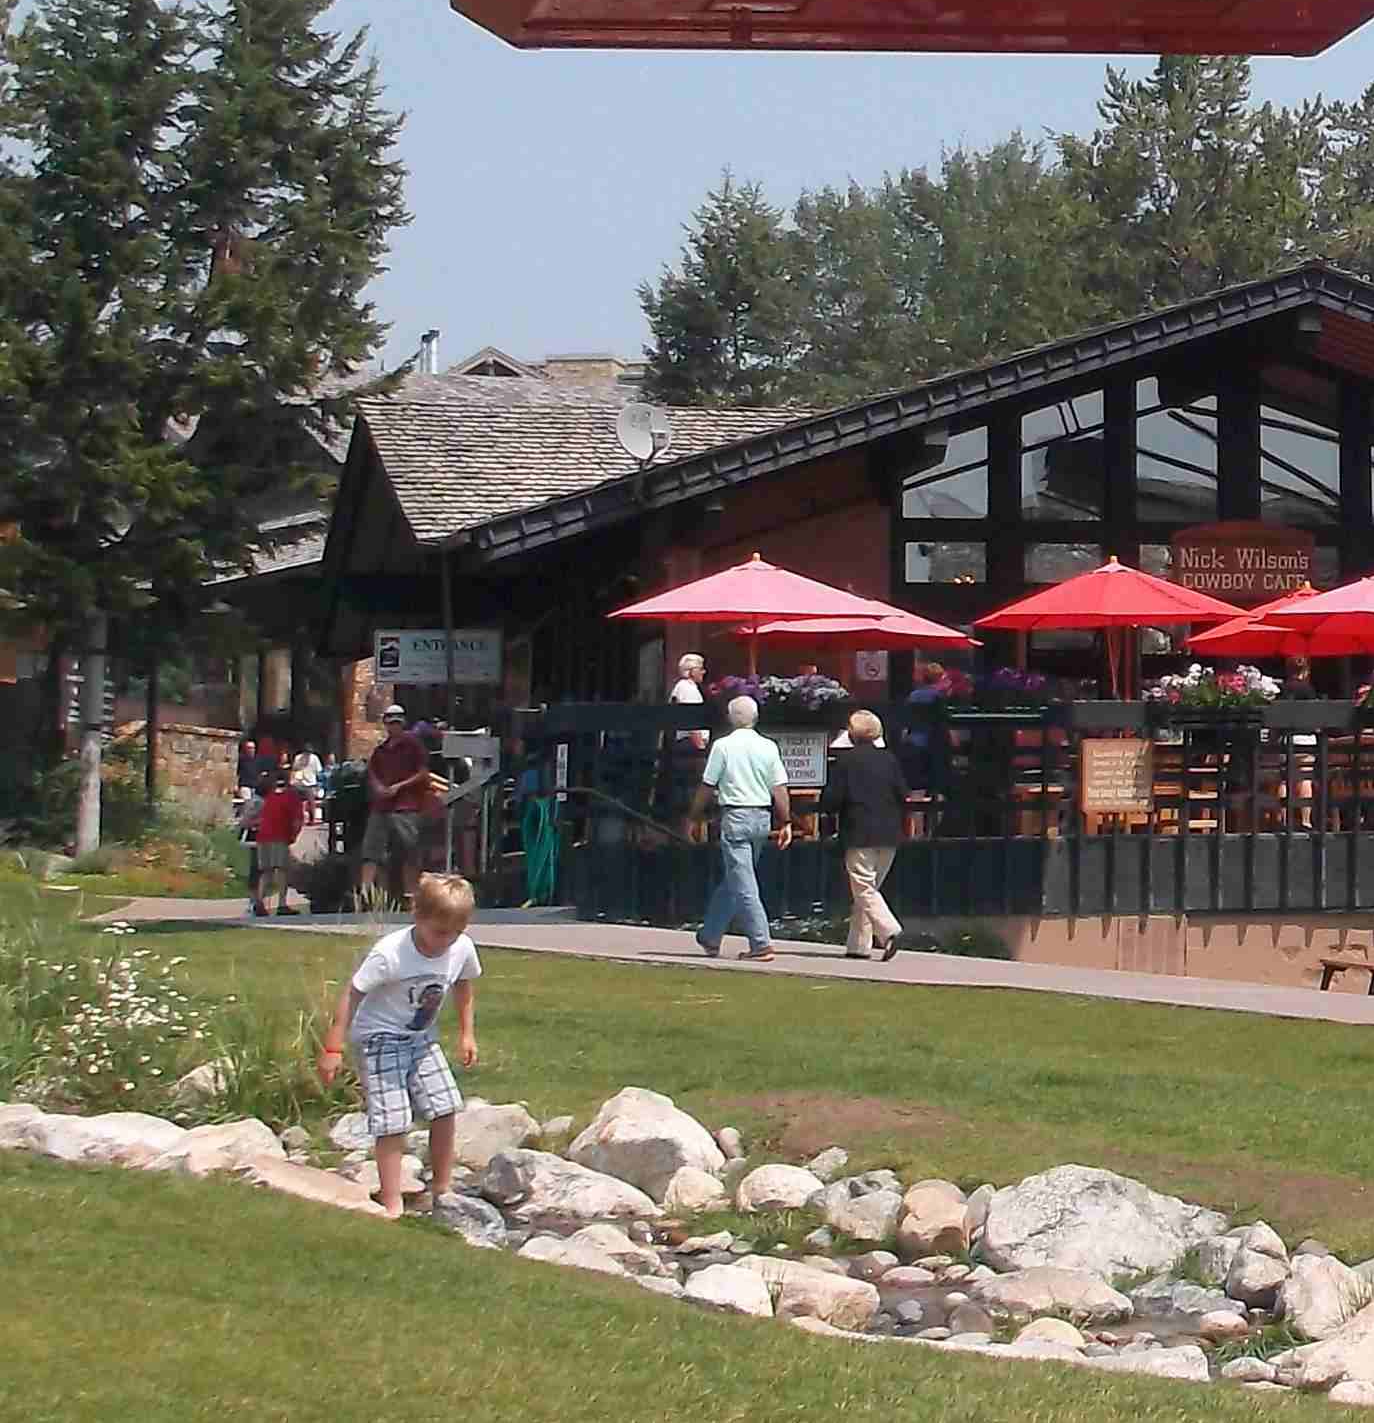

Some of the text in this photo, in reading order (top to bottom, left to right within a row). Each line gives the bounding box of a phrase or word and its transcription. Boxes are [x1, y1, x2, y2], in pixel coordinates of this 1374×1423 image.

[1180, 547, 1309, 570] Nick Wilson's
[1182, 573, 1256, 590] COWBOY
